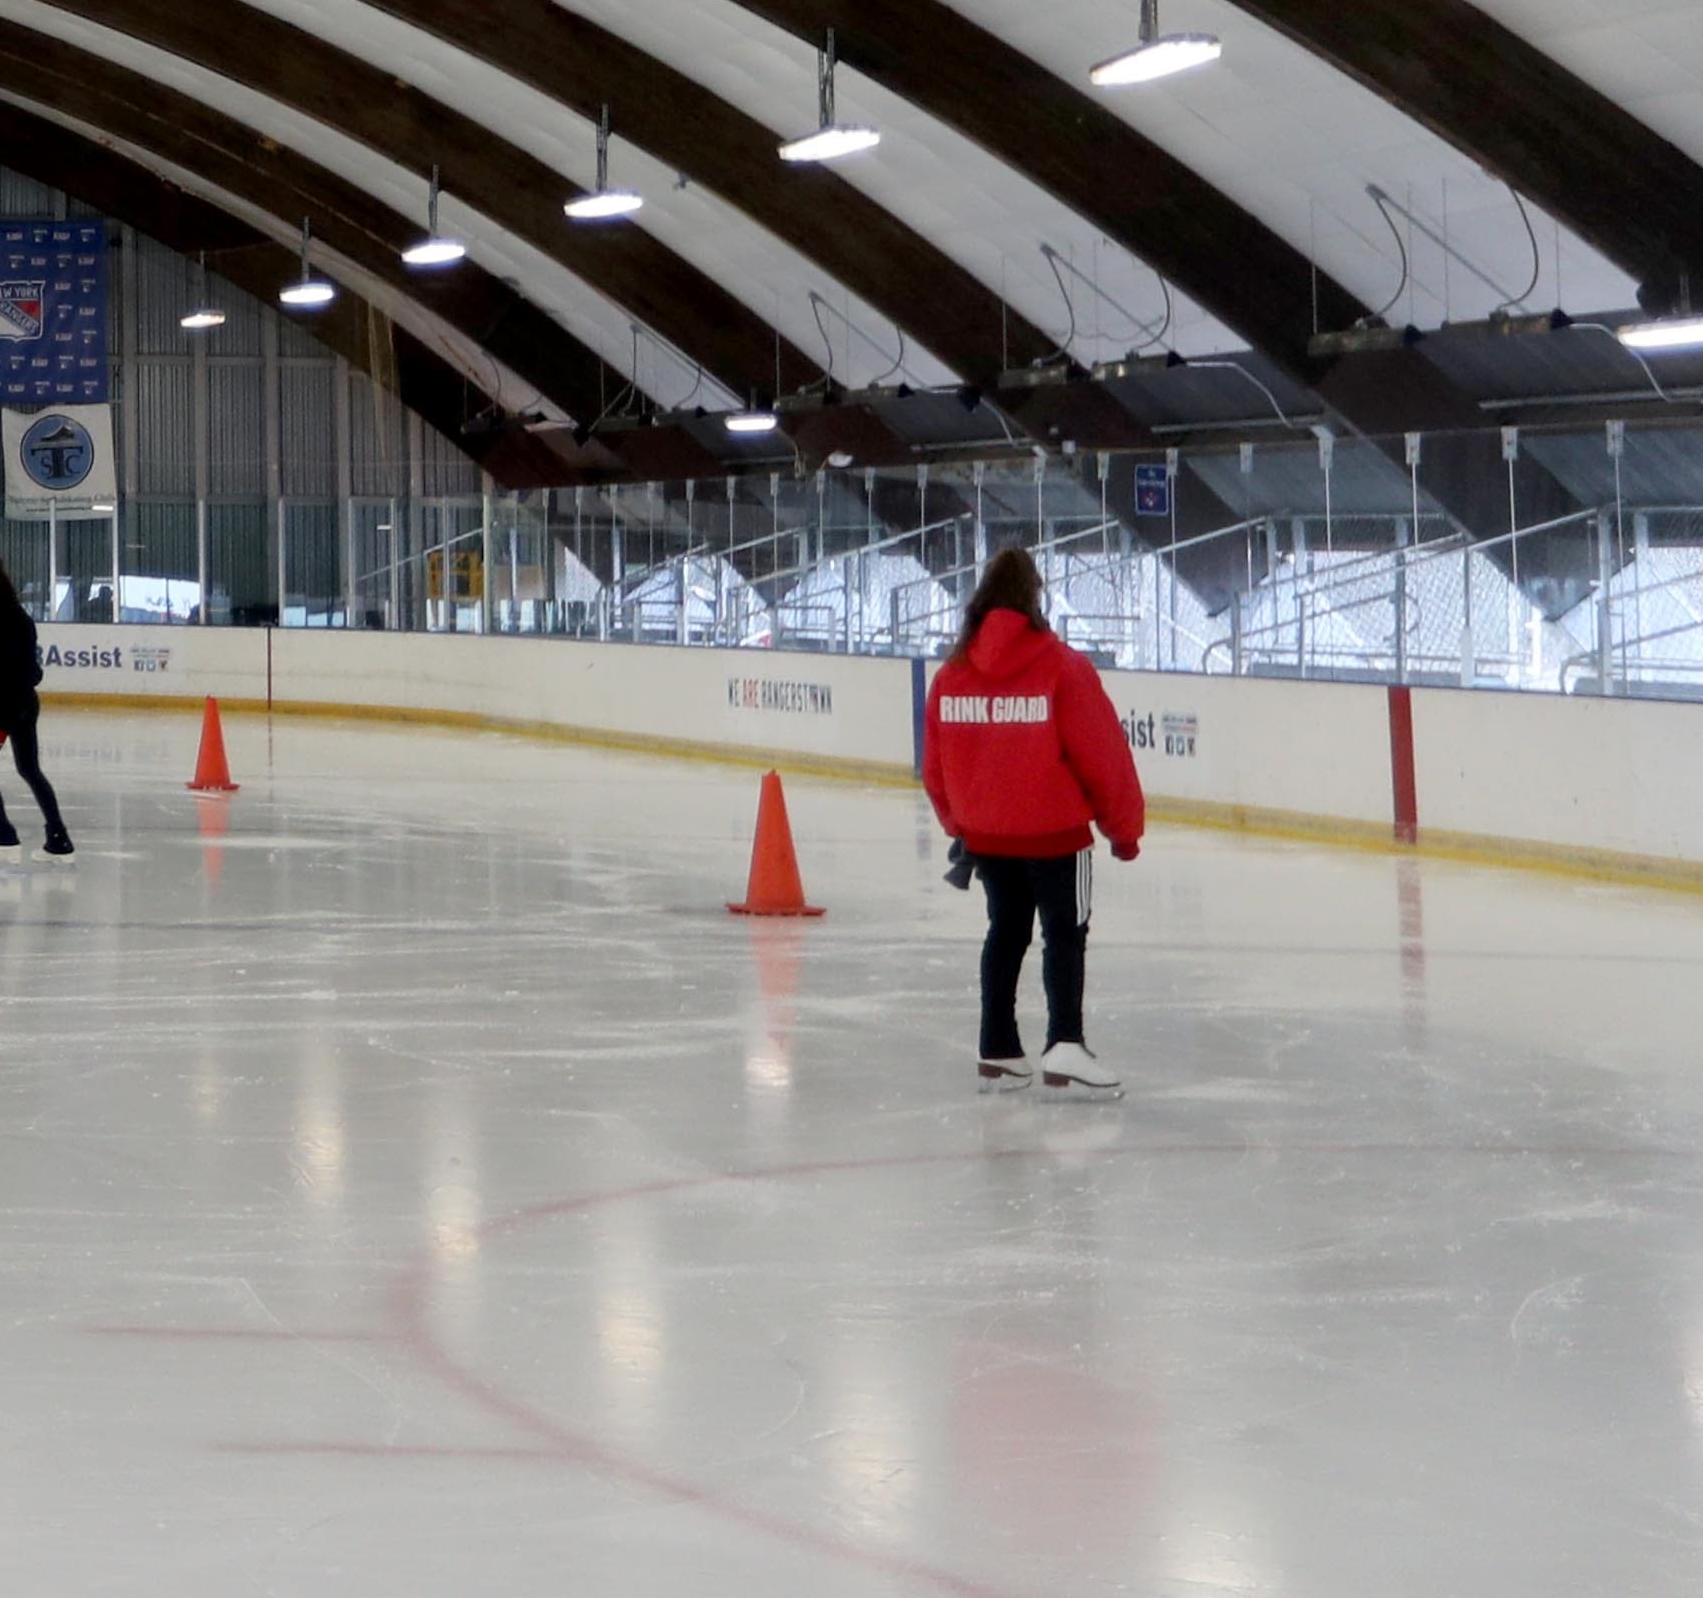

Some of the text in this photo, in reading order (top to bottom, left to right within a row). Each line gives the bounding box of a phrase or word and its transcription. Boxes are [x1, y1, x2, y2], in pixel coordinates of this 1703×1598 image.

[14, 287, 39, 298] YORK
[742, 678, 759, 709] ARE
[940, 695, 1049, 723] RINK GUARD
